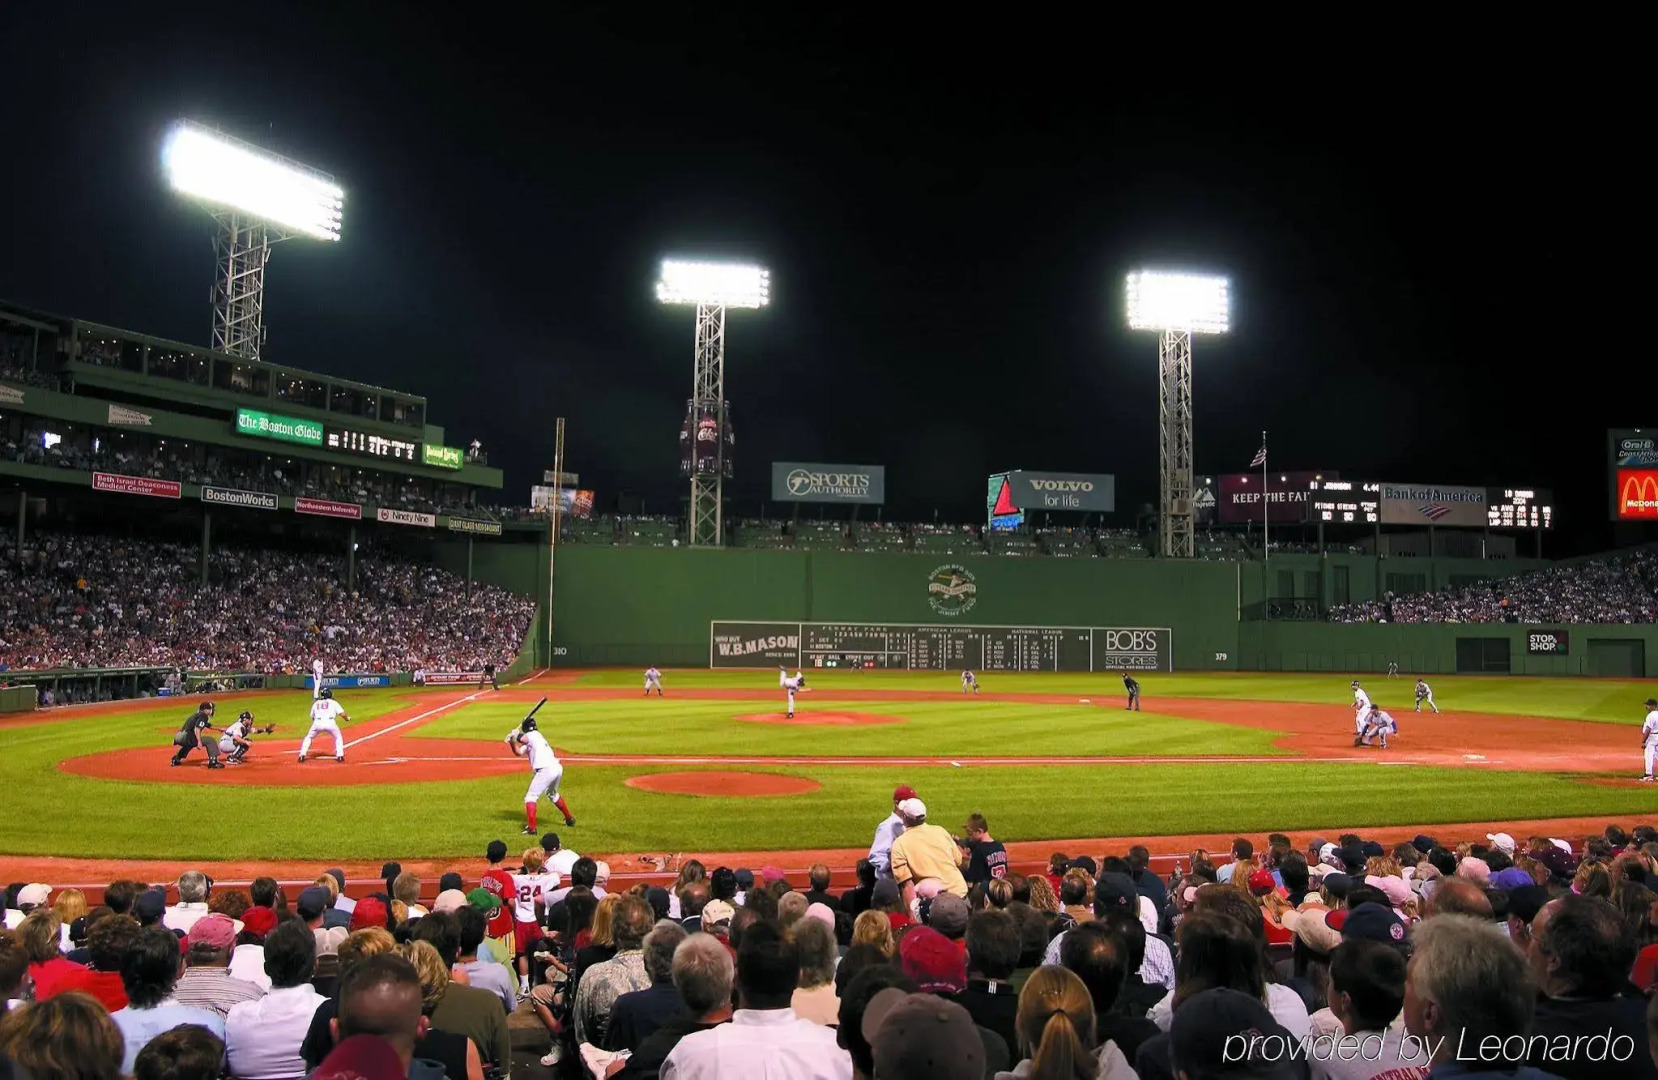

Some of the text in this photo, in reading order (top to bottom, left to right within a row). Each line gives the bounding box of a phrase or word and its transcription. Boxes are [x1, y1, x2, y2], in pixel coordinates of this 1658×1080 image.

[239, 414, 257, 429] The
[259, 418, 293, 435] Boston
[295, 425, 321, 440] Globe
[382, 446, 388, 455] 2
[407, 450, 413, 460] 2
[97, 475, 178, 491] Beth Israel Deaconess
[811, 473, 869, 487] SPORTS
[1029, 479, 1093, 492] VOLVO
[97, 481, 153, 493] Medical Center
[810, 486, 868, 495] AUTHORITY
[206, 489, 275, 507] BostonWorks
[1045, 494, 1080, 507] for life
[1233, 492, 1310, 503] KEEP THE FAI
[1384, 487, 1415, 500] Bank
[1431, 490, 1483, 502] America
[297, 501, 357, 515] Northeastern University
[392, 511, 429, 523] Ninety Nine
[1106, 630, 1157, 650] BOB'S
[1530, 642, 1555, 650] SHOP
[553, 647, 567, 656] 310
[1105, 656, 1157, 666] STORES
